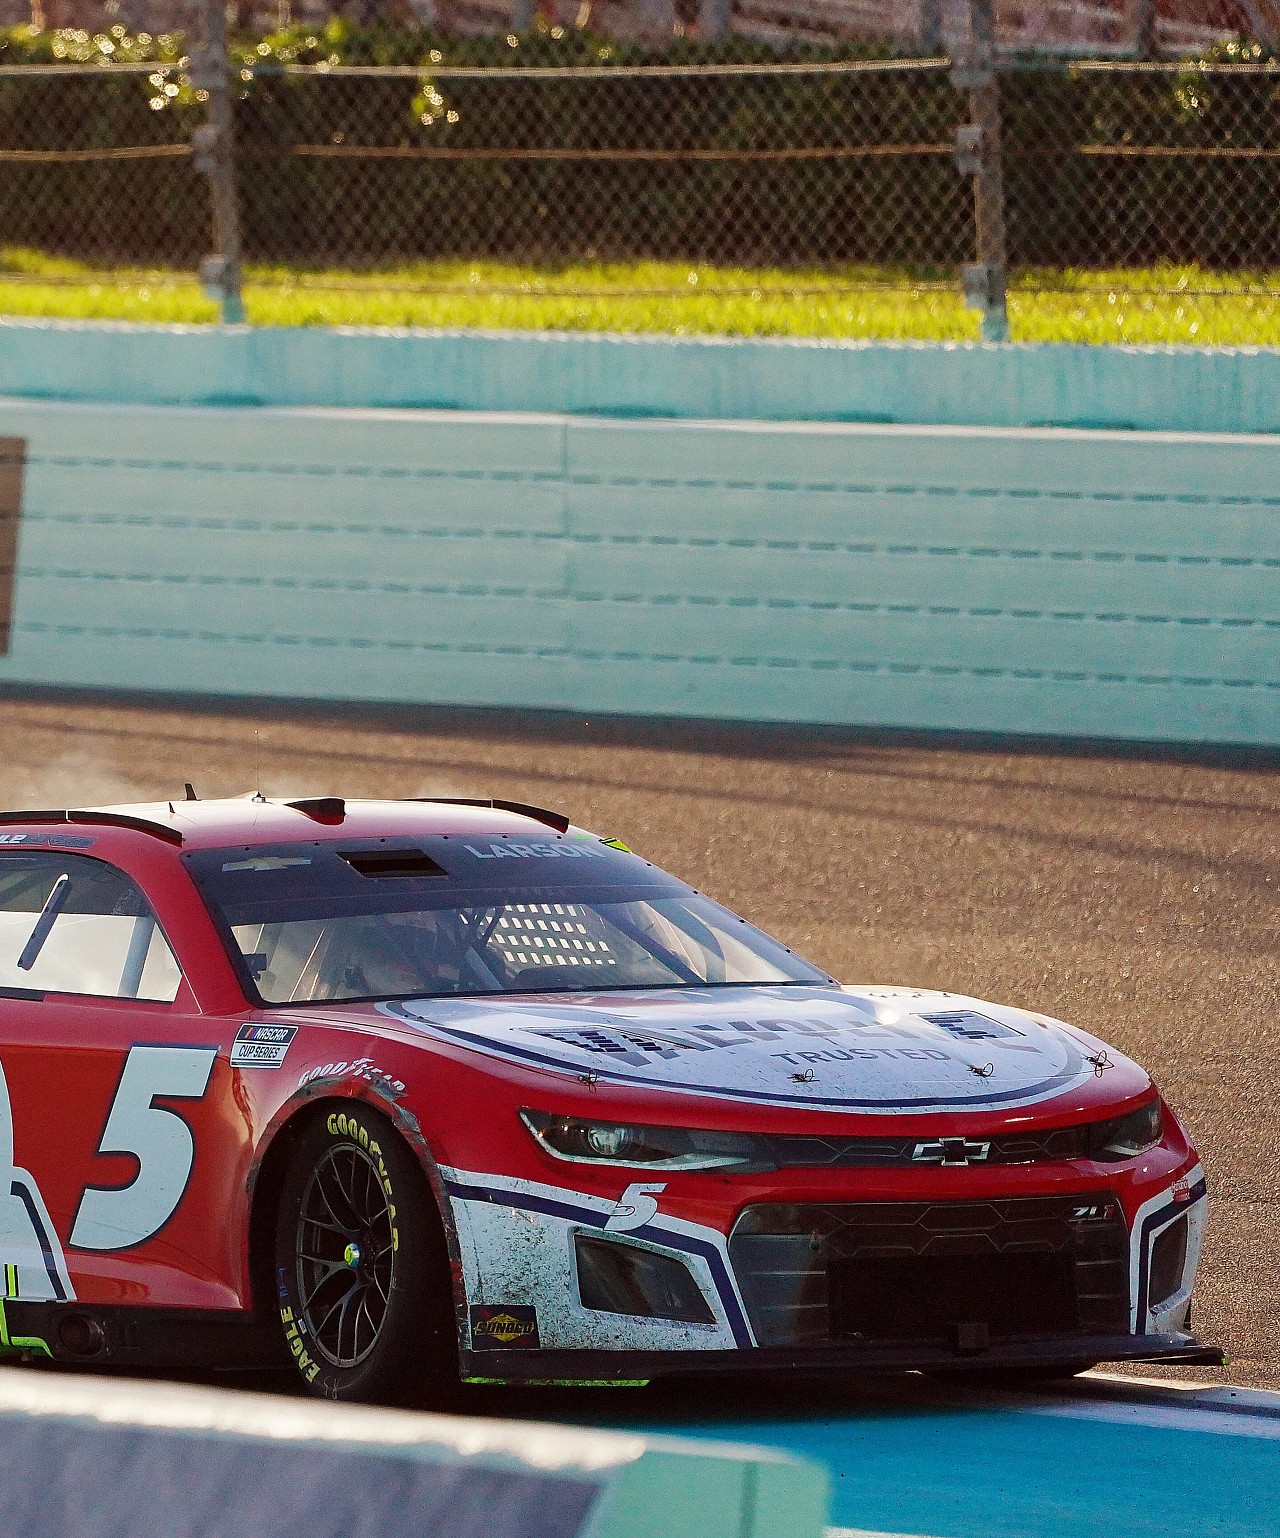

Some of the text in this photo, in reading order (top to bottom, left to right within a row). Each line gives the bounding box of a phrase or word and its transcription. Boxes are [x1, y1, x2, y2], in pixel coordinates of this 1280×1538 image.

[463, 844, 606, 859] LARSON
[254, 1027, 289, 1041] NASCAR
[238, 1045, 281, 1058] CUP SERIES
[771, 1048, 951, 1065] TRUSTED
[68, 1044, 220, 1251] 5
[603, 1183, 668, 1231] 5
[473, 1320, 535, 1335] SUNOCO
[281, 1305, 320, 1383] EAGLE
